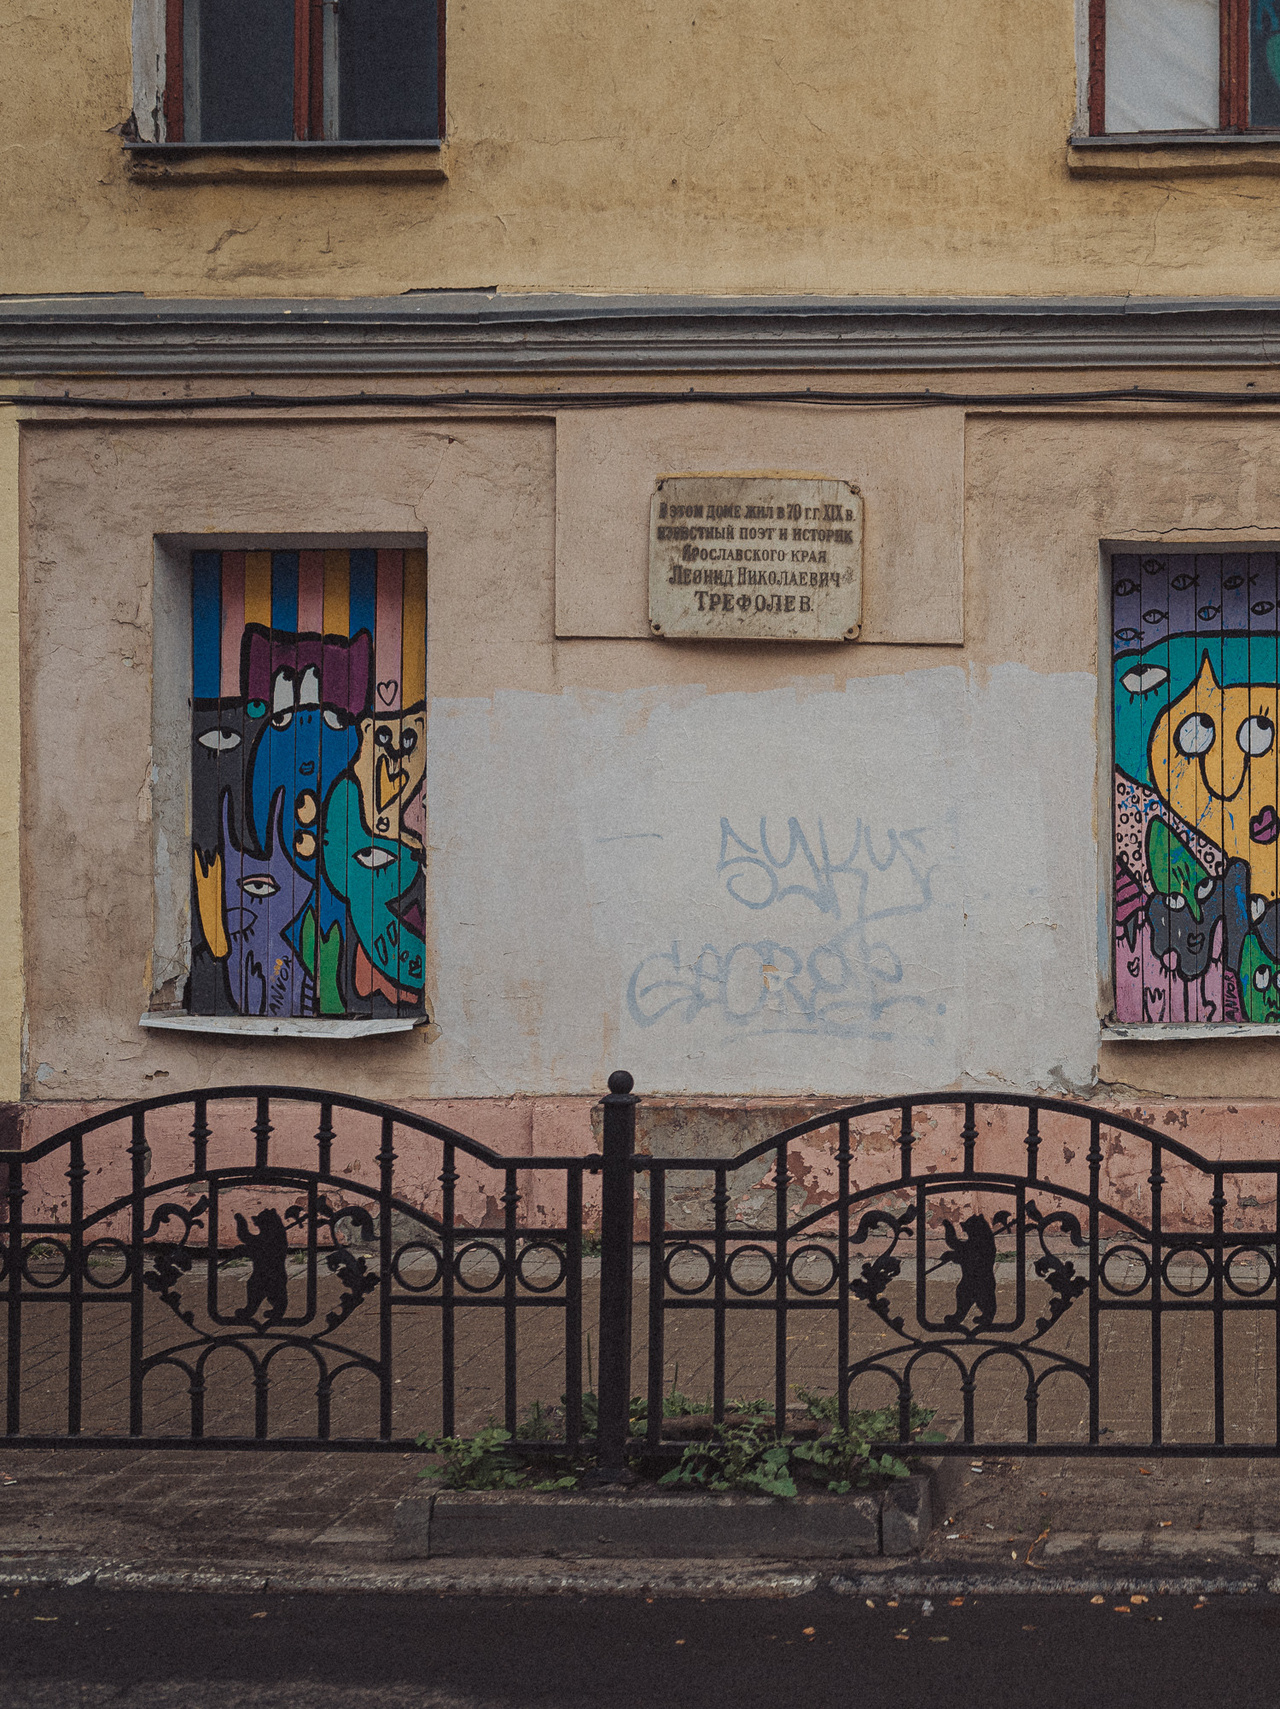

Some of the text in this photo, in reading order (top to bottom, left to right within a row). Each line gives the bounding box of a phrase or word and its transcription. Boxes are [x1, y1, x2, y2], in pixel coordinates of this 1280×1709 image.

[669, 504, 704, 519] ЭТОМ
[706, 504, 742, 521] ДОМЕ
[744, 505, 774, 519] ЖИЛ
[776, 506, 786, 519] В
[787, 503, 802, 521] 70
[845, 509, 857, 522] В.
[657, 525, 853, 545] ИЗВЕСТНЫЙ ПОЭТ И ИСТОРИК
[682, 543, 827, 563] ЯРОСЛАВСКОГО КРАЯ
[668, 564, 841, 588] ЛЕОНИД НИКОЛАЕВИЧ
[694, 590, 814, 613] ТРЕФОЛЕВ.
